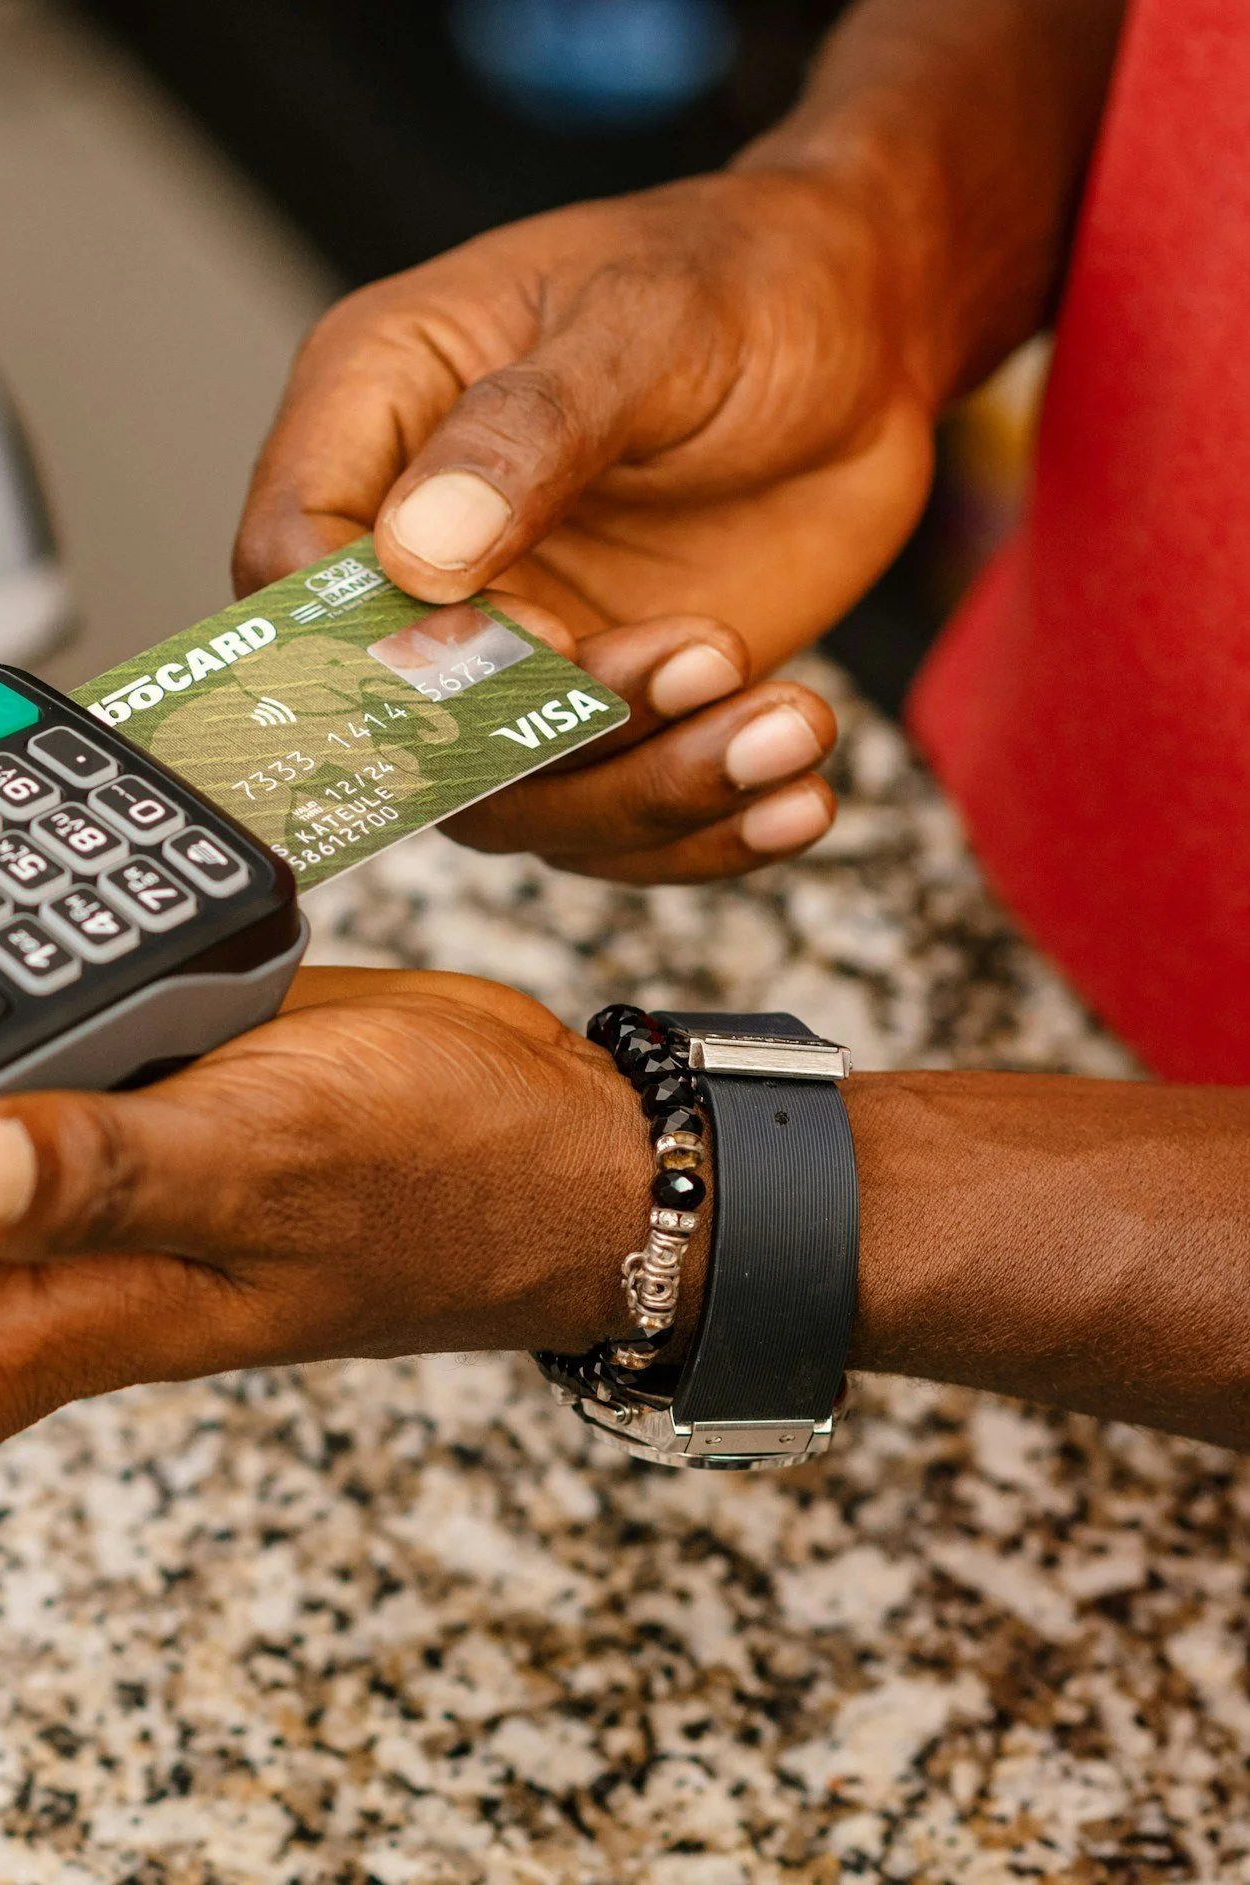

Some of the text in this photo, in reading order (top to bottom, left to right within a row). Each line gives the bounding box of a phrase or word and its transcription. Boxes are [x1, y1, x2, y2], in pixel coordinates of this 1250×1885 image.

[324, 572, 379, 604] BANK
[231, 655, 496, 800] 7333 1414 5673
[489, 689, 610, 749] VISA
[2, 777, 40, 800] 9
[325, 760, 395, 800] 12/24
[291, 800, 319, 817] VALID
[295, 786, 394, 844] KATEULE
[300, 806, 324, 822] THRU
[69, 825, 108, 852] 8
[288, 805, 399, 871] 58612700
[8, 855, 47, 881] 5
[137, 888, 178, 910] 7
[81, 911, 120, 935] 4
[24, 943, 57, 968] 1
